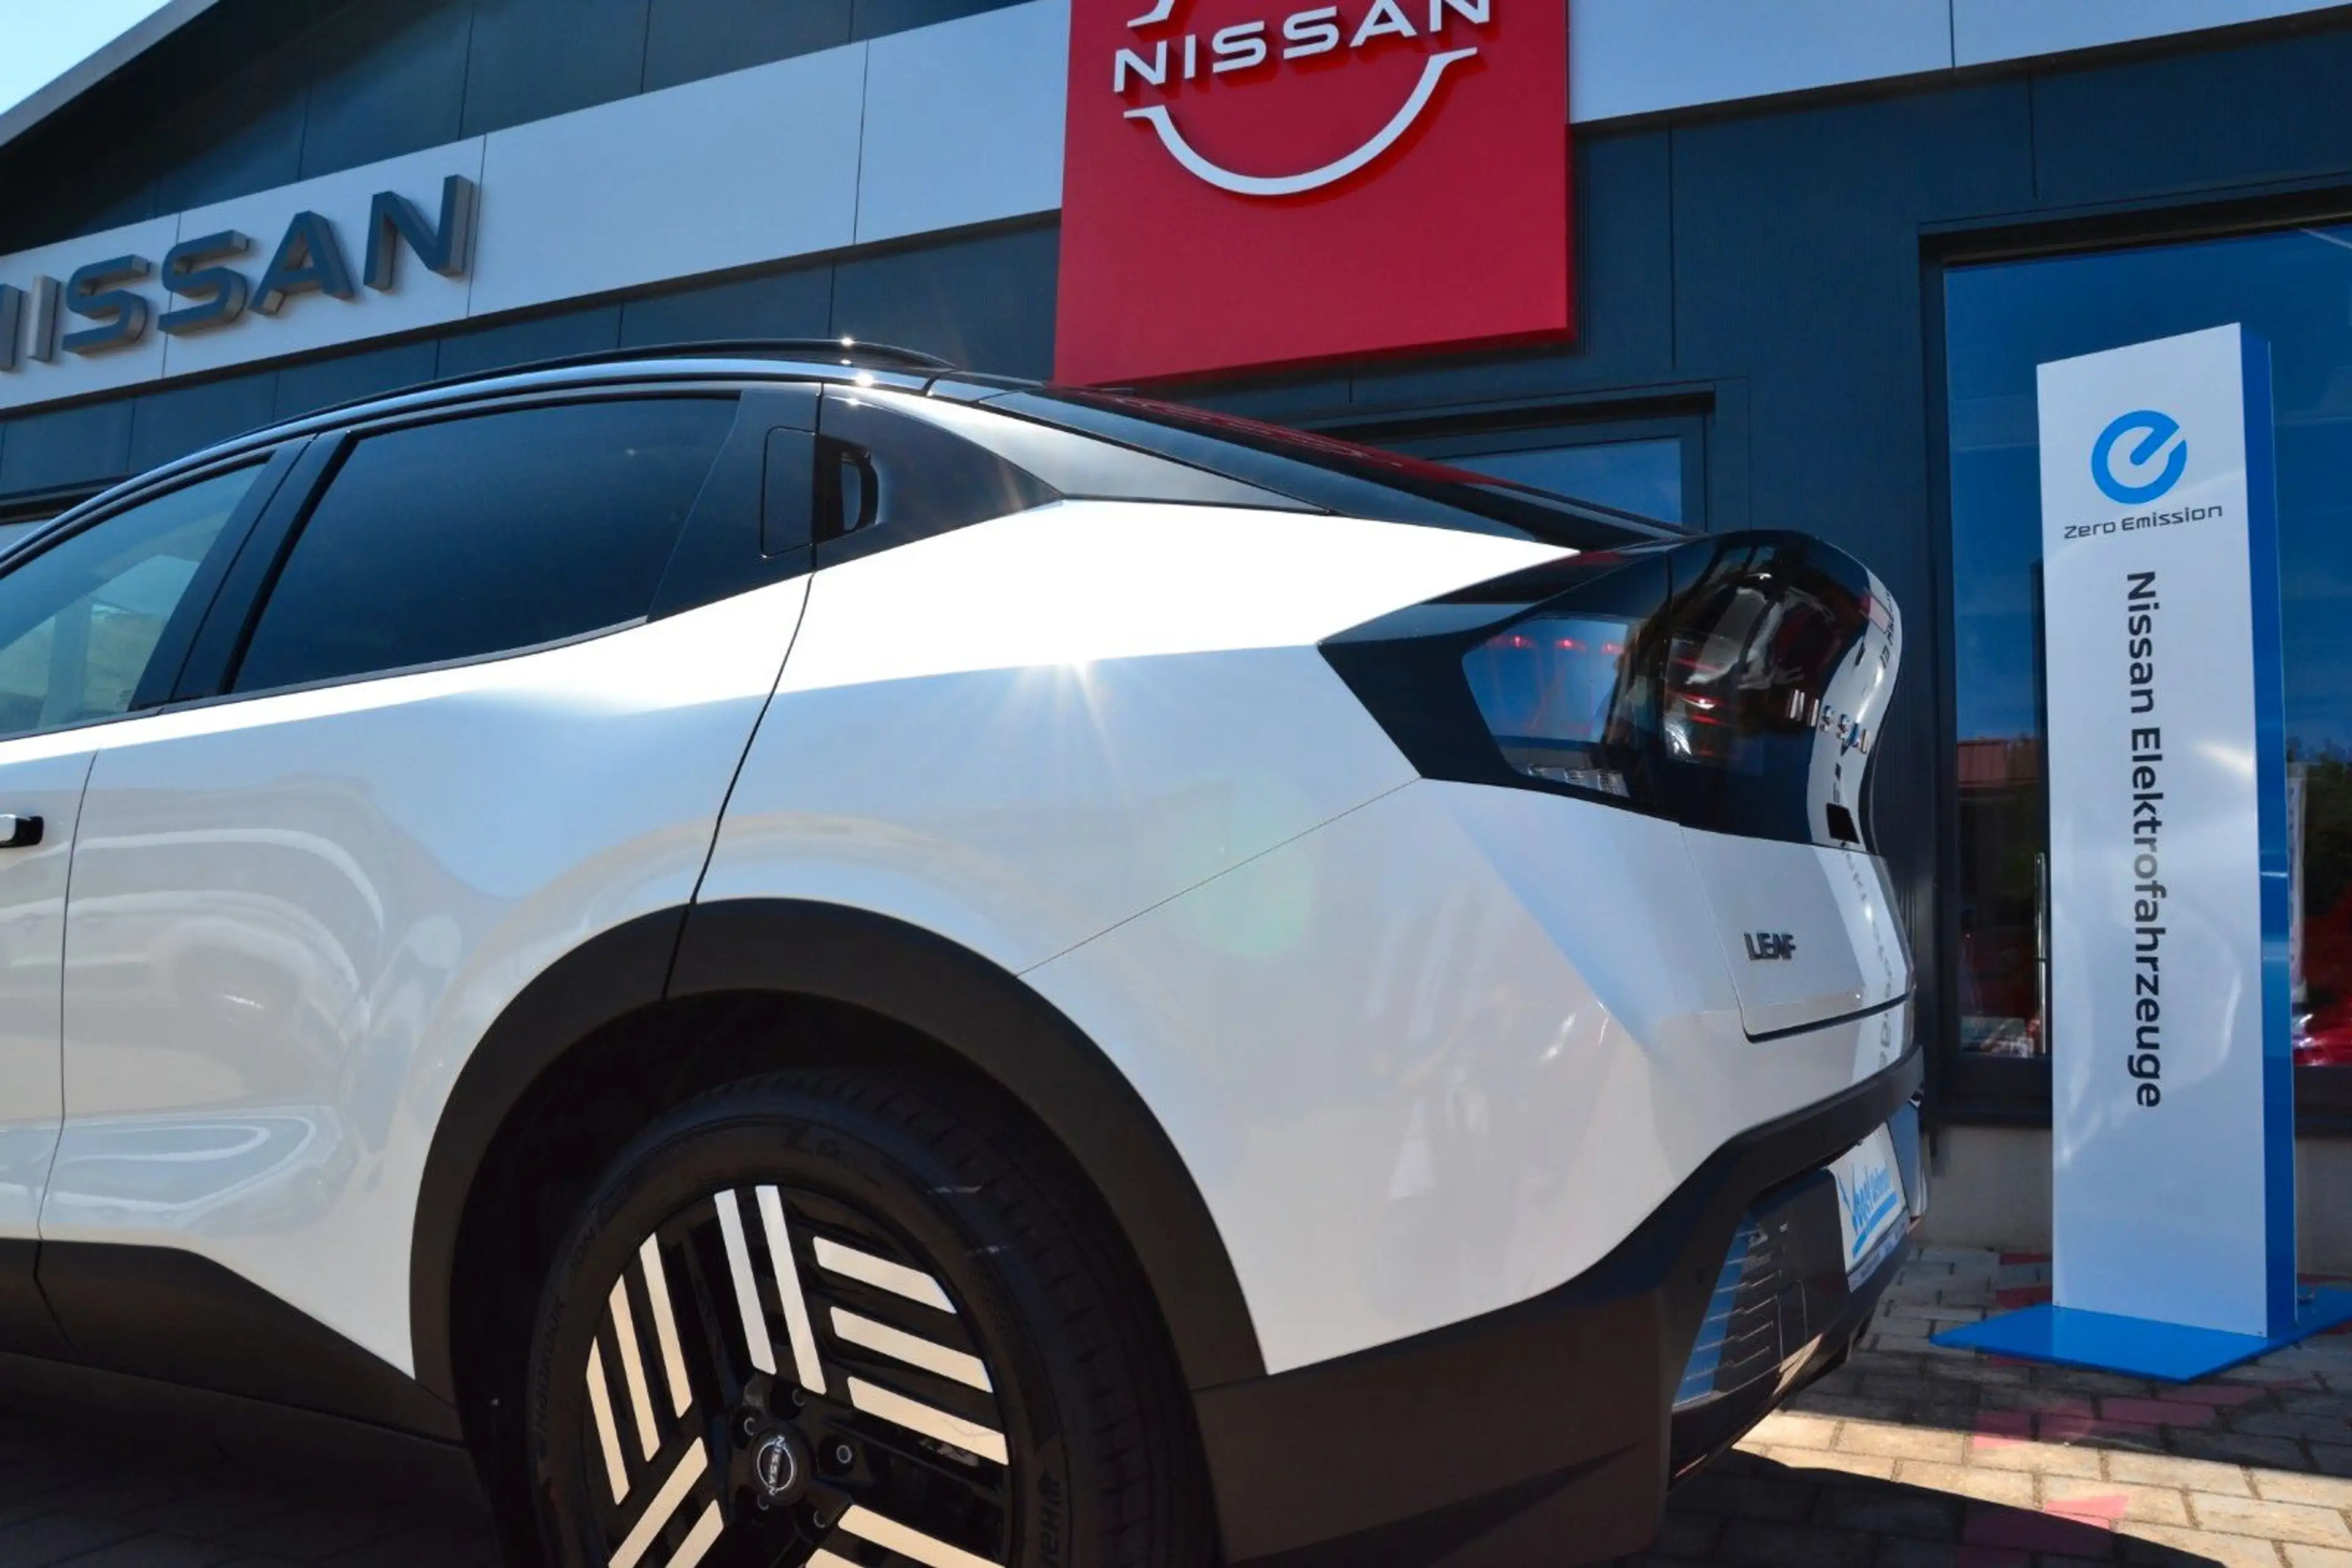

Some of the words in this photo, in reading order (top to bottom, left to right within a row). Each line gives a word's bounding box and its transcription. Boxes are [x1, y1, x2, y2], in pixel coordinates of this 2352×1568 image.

[1114, 0, 1490, 93] NISSAN
[2121, 505, 2223, 531] Emission
[2127, 571, 2160, 714] Nissan
[1743, 932, 1796, 961] LEAF
[2127, 727, 2167, 1108] Elektrofahrzeuge
